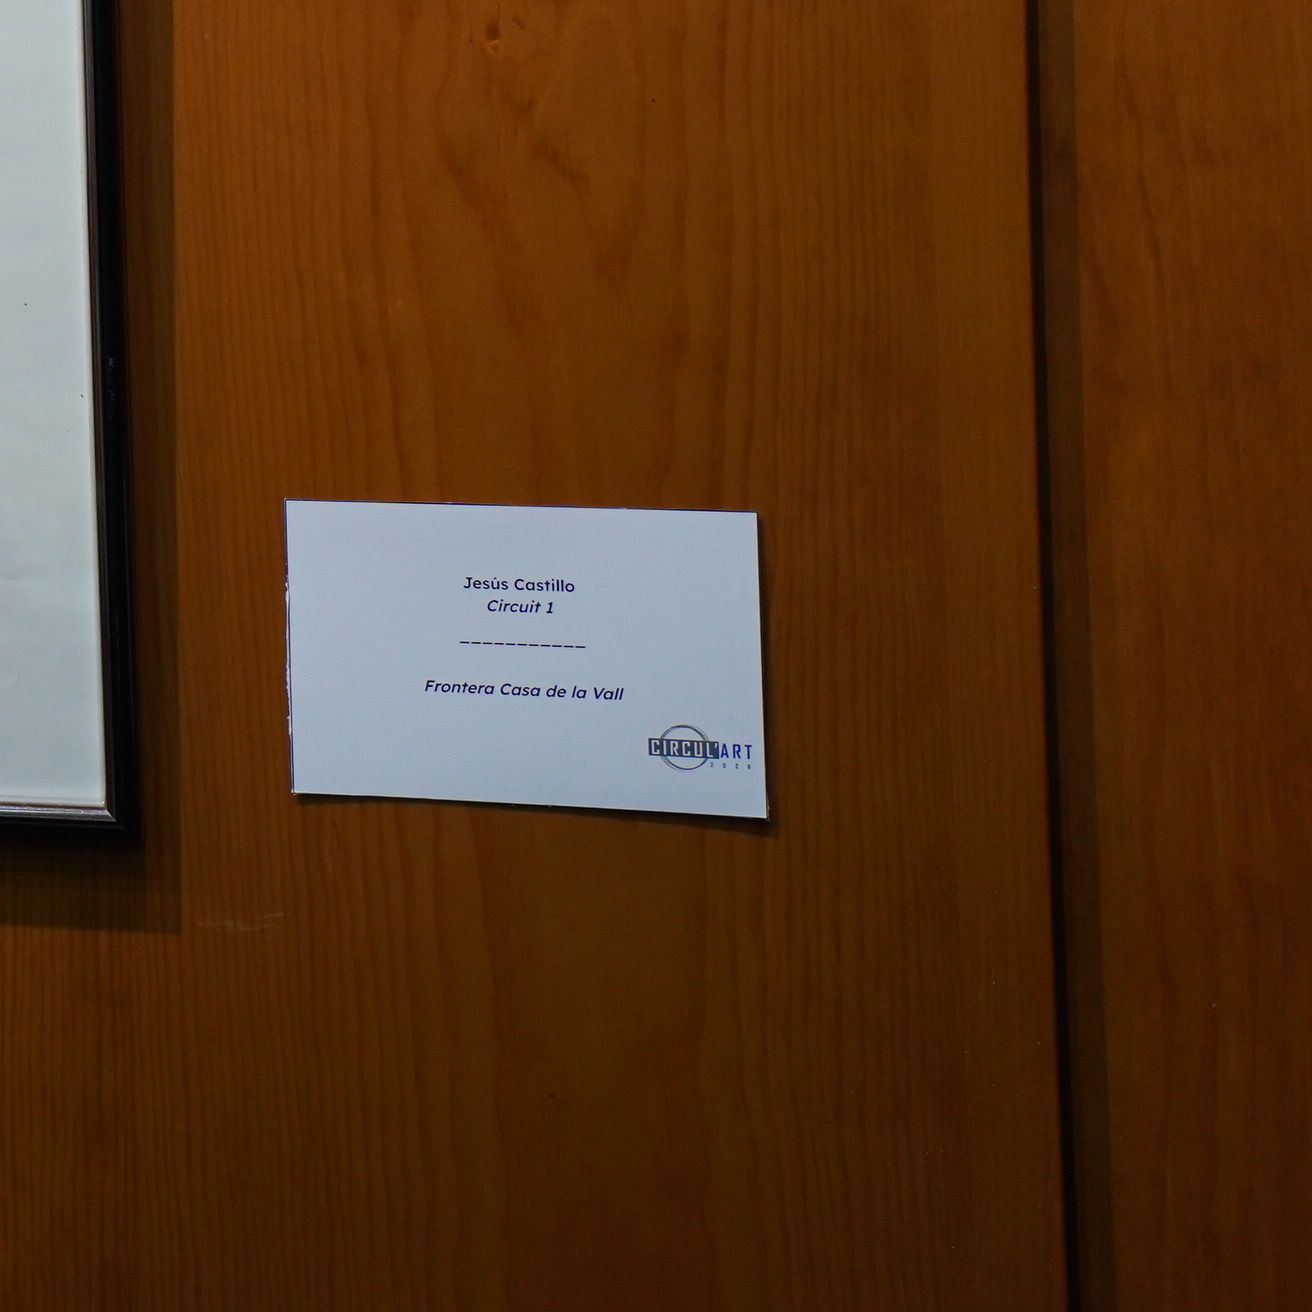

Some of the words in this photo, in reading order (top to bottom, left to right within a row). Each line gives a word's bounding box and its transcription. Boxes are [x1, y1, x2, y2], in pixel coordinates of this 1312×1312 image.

[463, 576, 509, 590] Jesús
[514, 578, 576, 593] Castillo
[487, 599, 542, 614] Circuit
[546, 601, 555, 614] 1
[424, 679, 495, 695] Frontera
[500, 683, 541, 697] Casa
[546, 684, 567, 698] de
[572, 686, 587, 699] la
[593, 687, 624, 701] Vall
